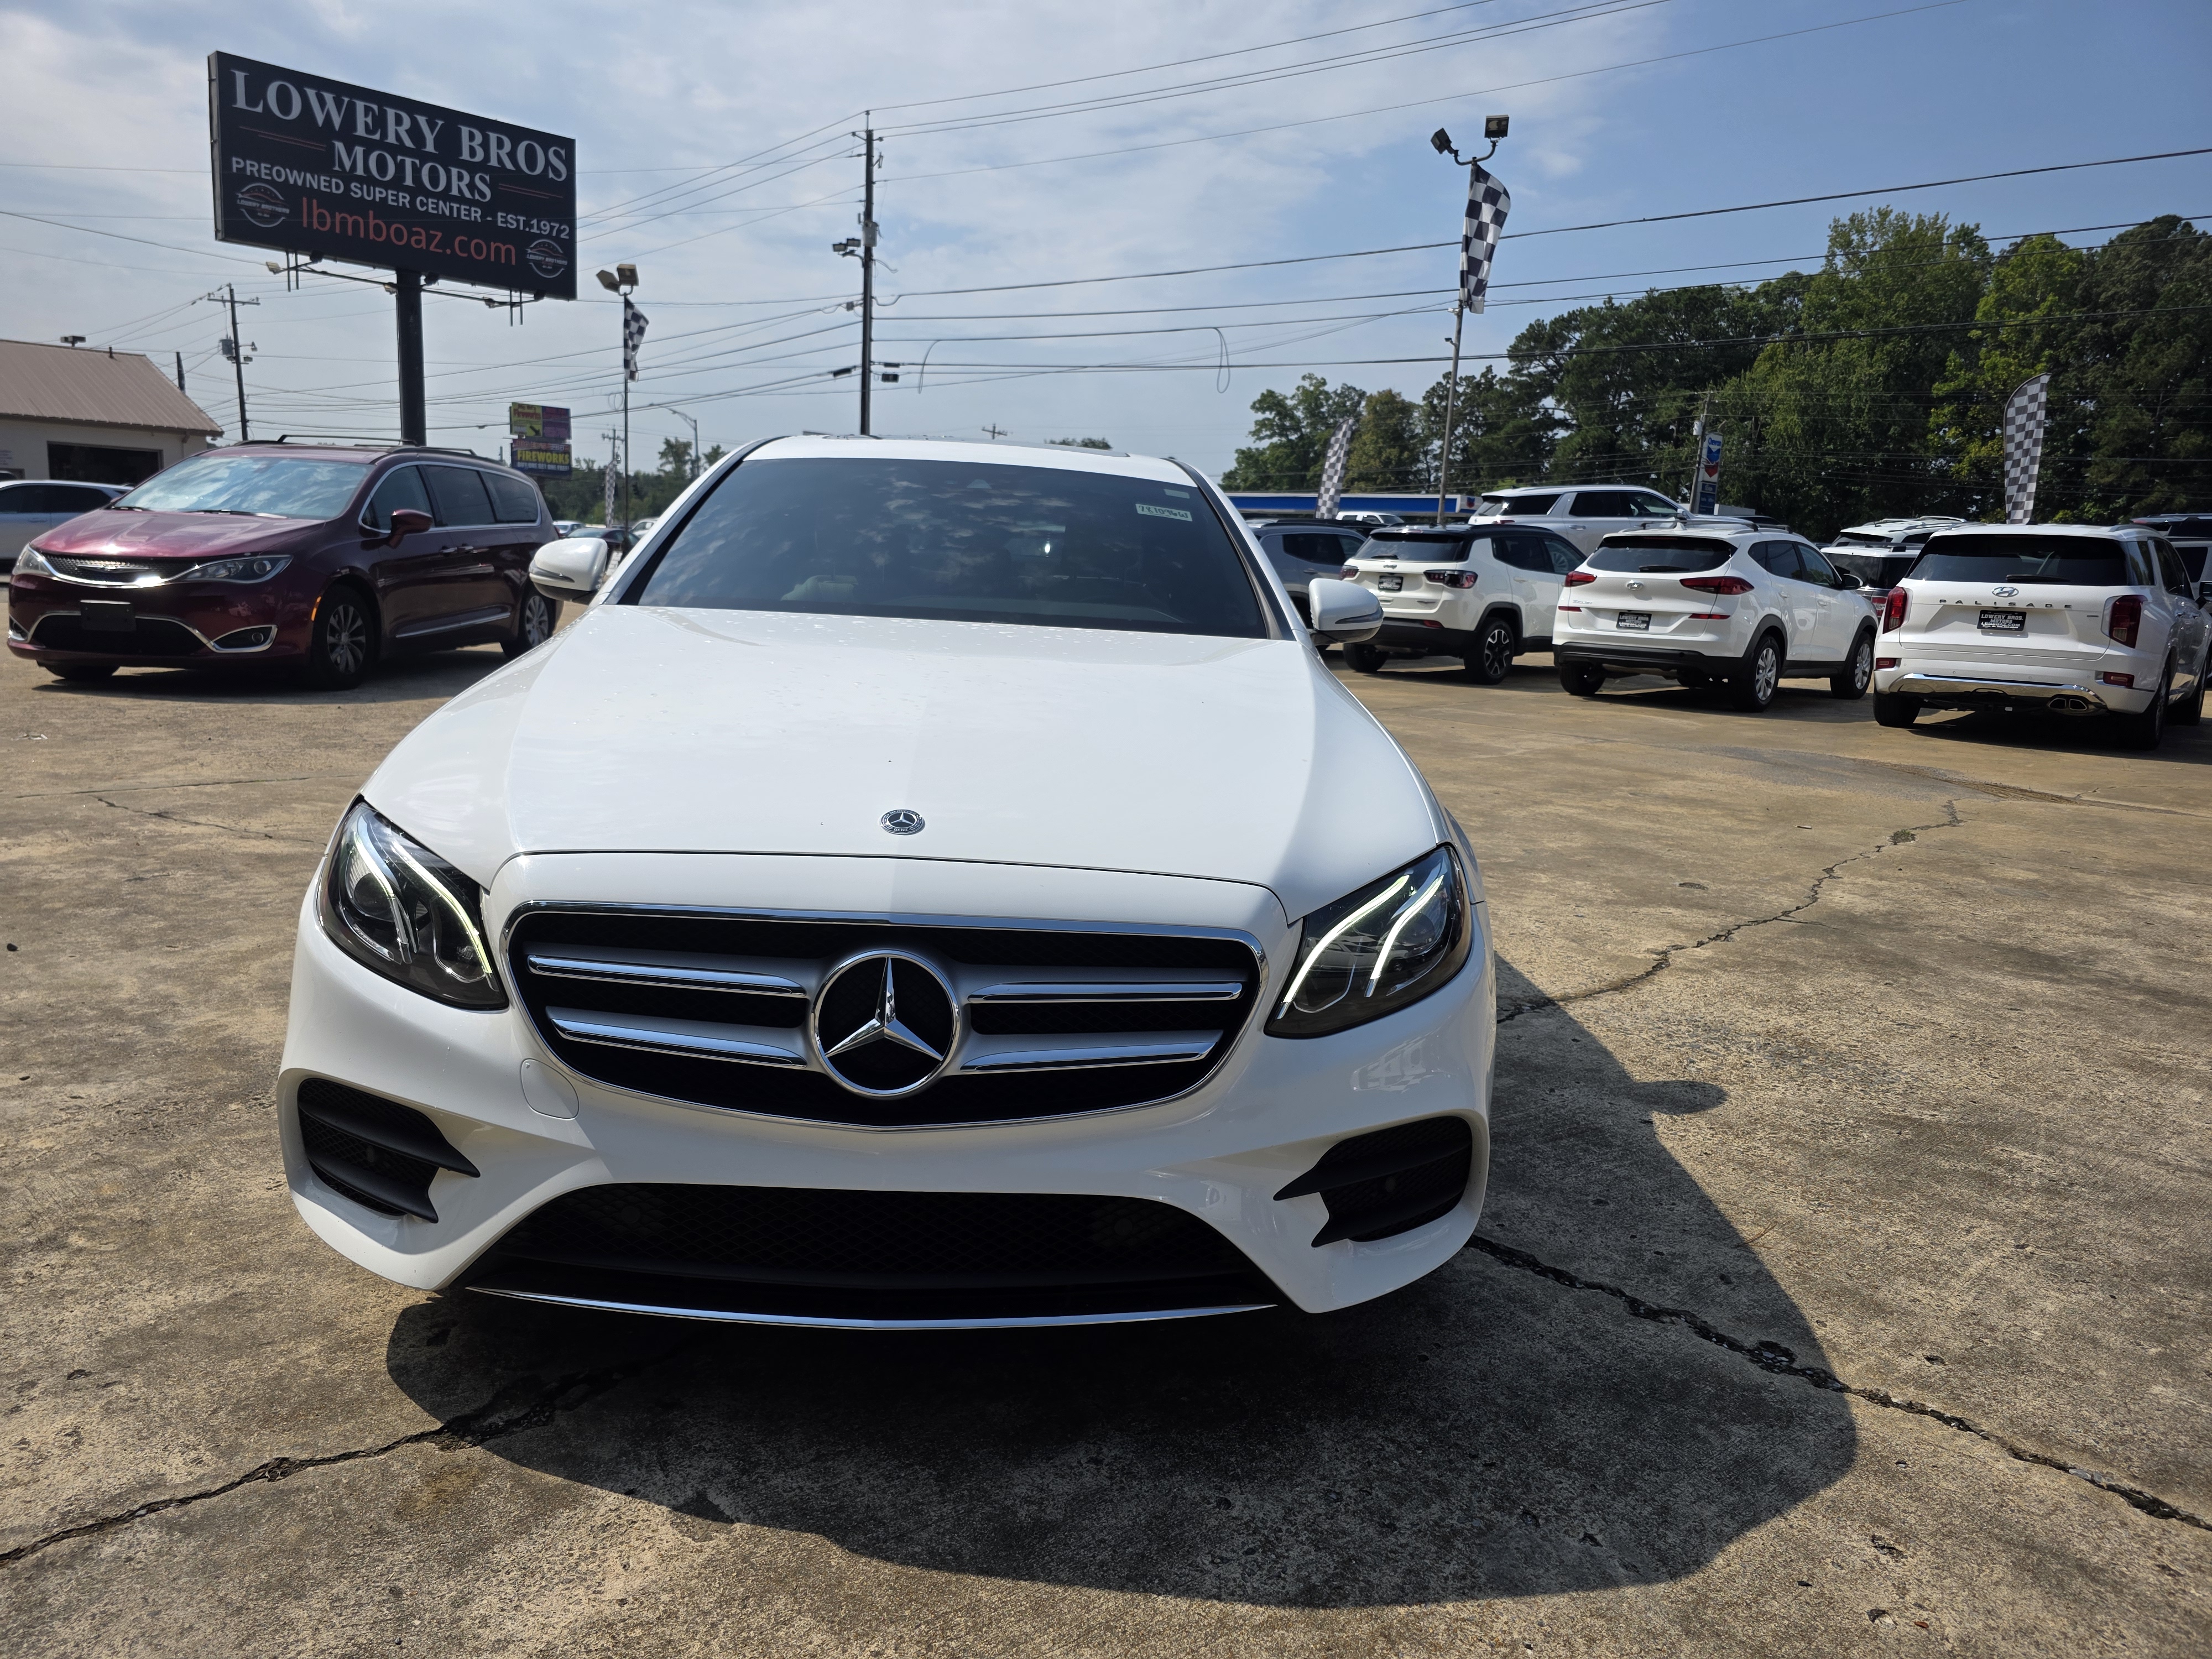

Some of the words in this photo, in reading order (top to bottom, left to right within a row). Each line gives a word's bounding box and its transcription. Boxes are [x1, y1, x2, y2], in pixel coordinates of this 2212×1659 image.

[230, 69, 445, 154] LOWERY
[457, 124, 567, 182] BROS
[232, 156, 345, 194] PREOWNED
[350, 182, 410, 208] SUPER
[416, 196, 482, 222] CENTER
[497, 211, 570, 239] EST.1972
[332, 140, 492, 202] MOTORS
[302, 196, 516, 266] lbmboaz.com
[517, 450, 570, 465] FIREWORKS
[1939, 599, 2073, 609] PALISADE
